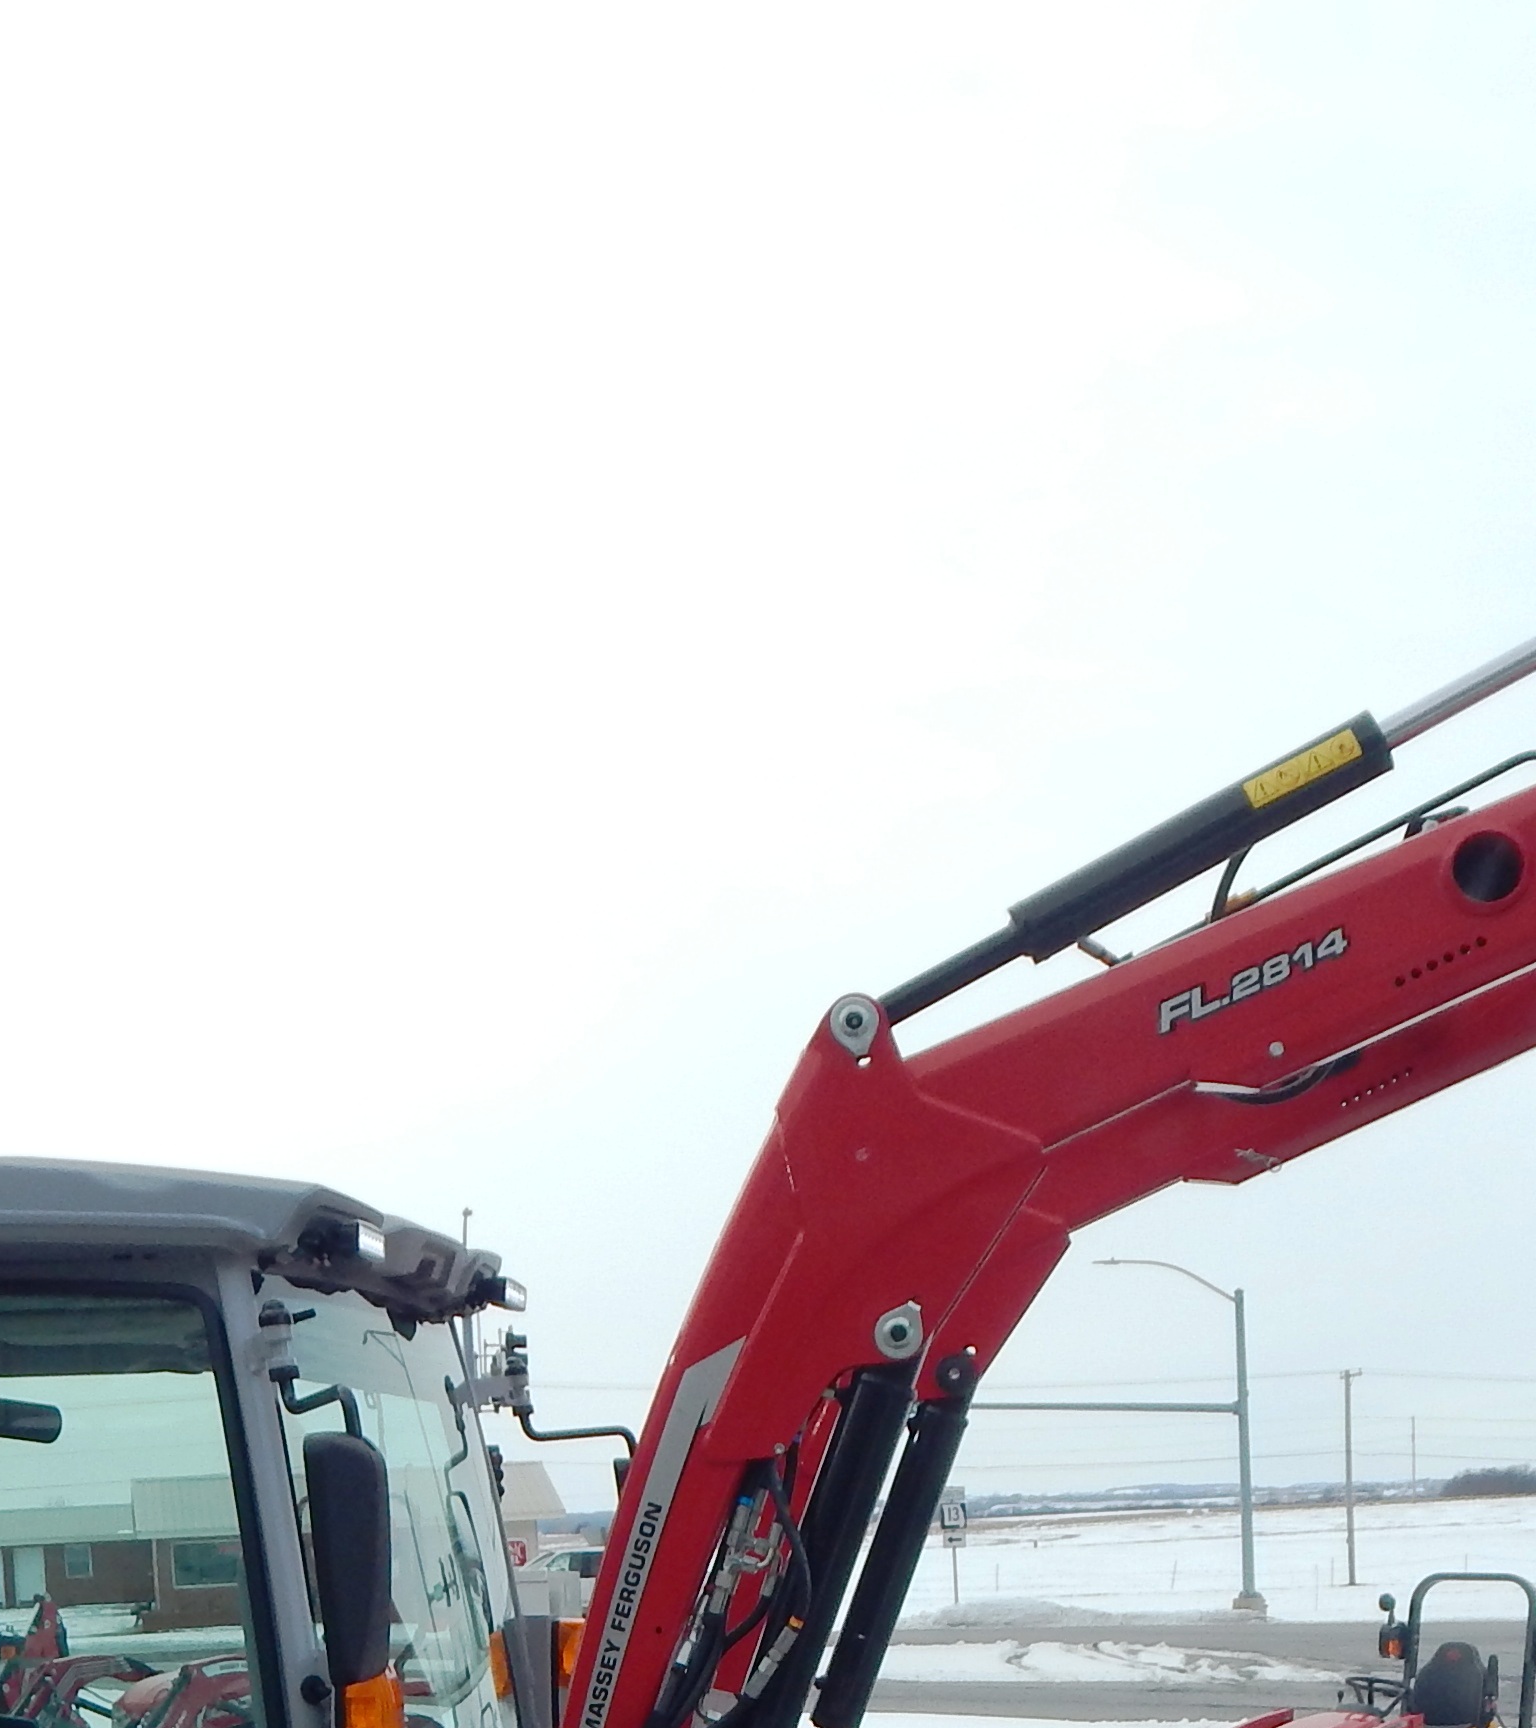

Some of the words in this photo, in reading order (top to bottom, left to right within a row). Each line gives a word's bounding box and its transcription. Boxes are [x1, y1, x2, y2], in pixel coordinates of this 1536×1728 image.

[1159, 927, 1349, 1035] FL.2814
[610, 1501, 663, 1633] FERGUSON
[947, 1506, 961, 1522] 13
